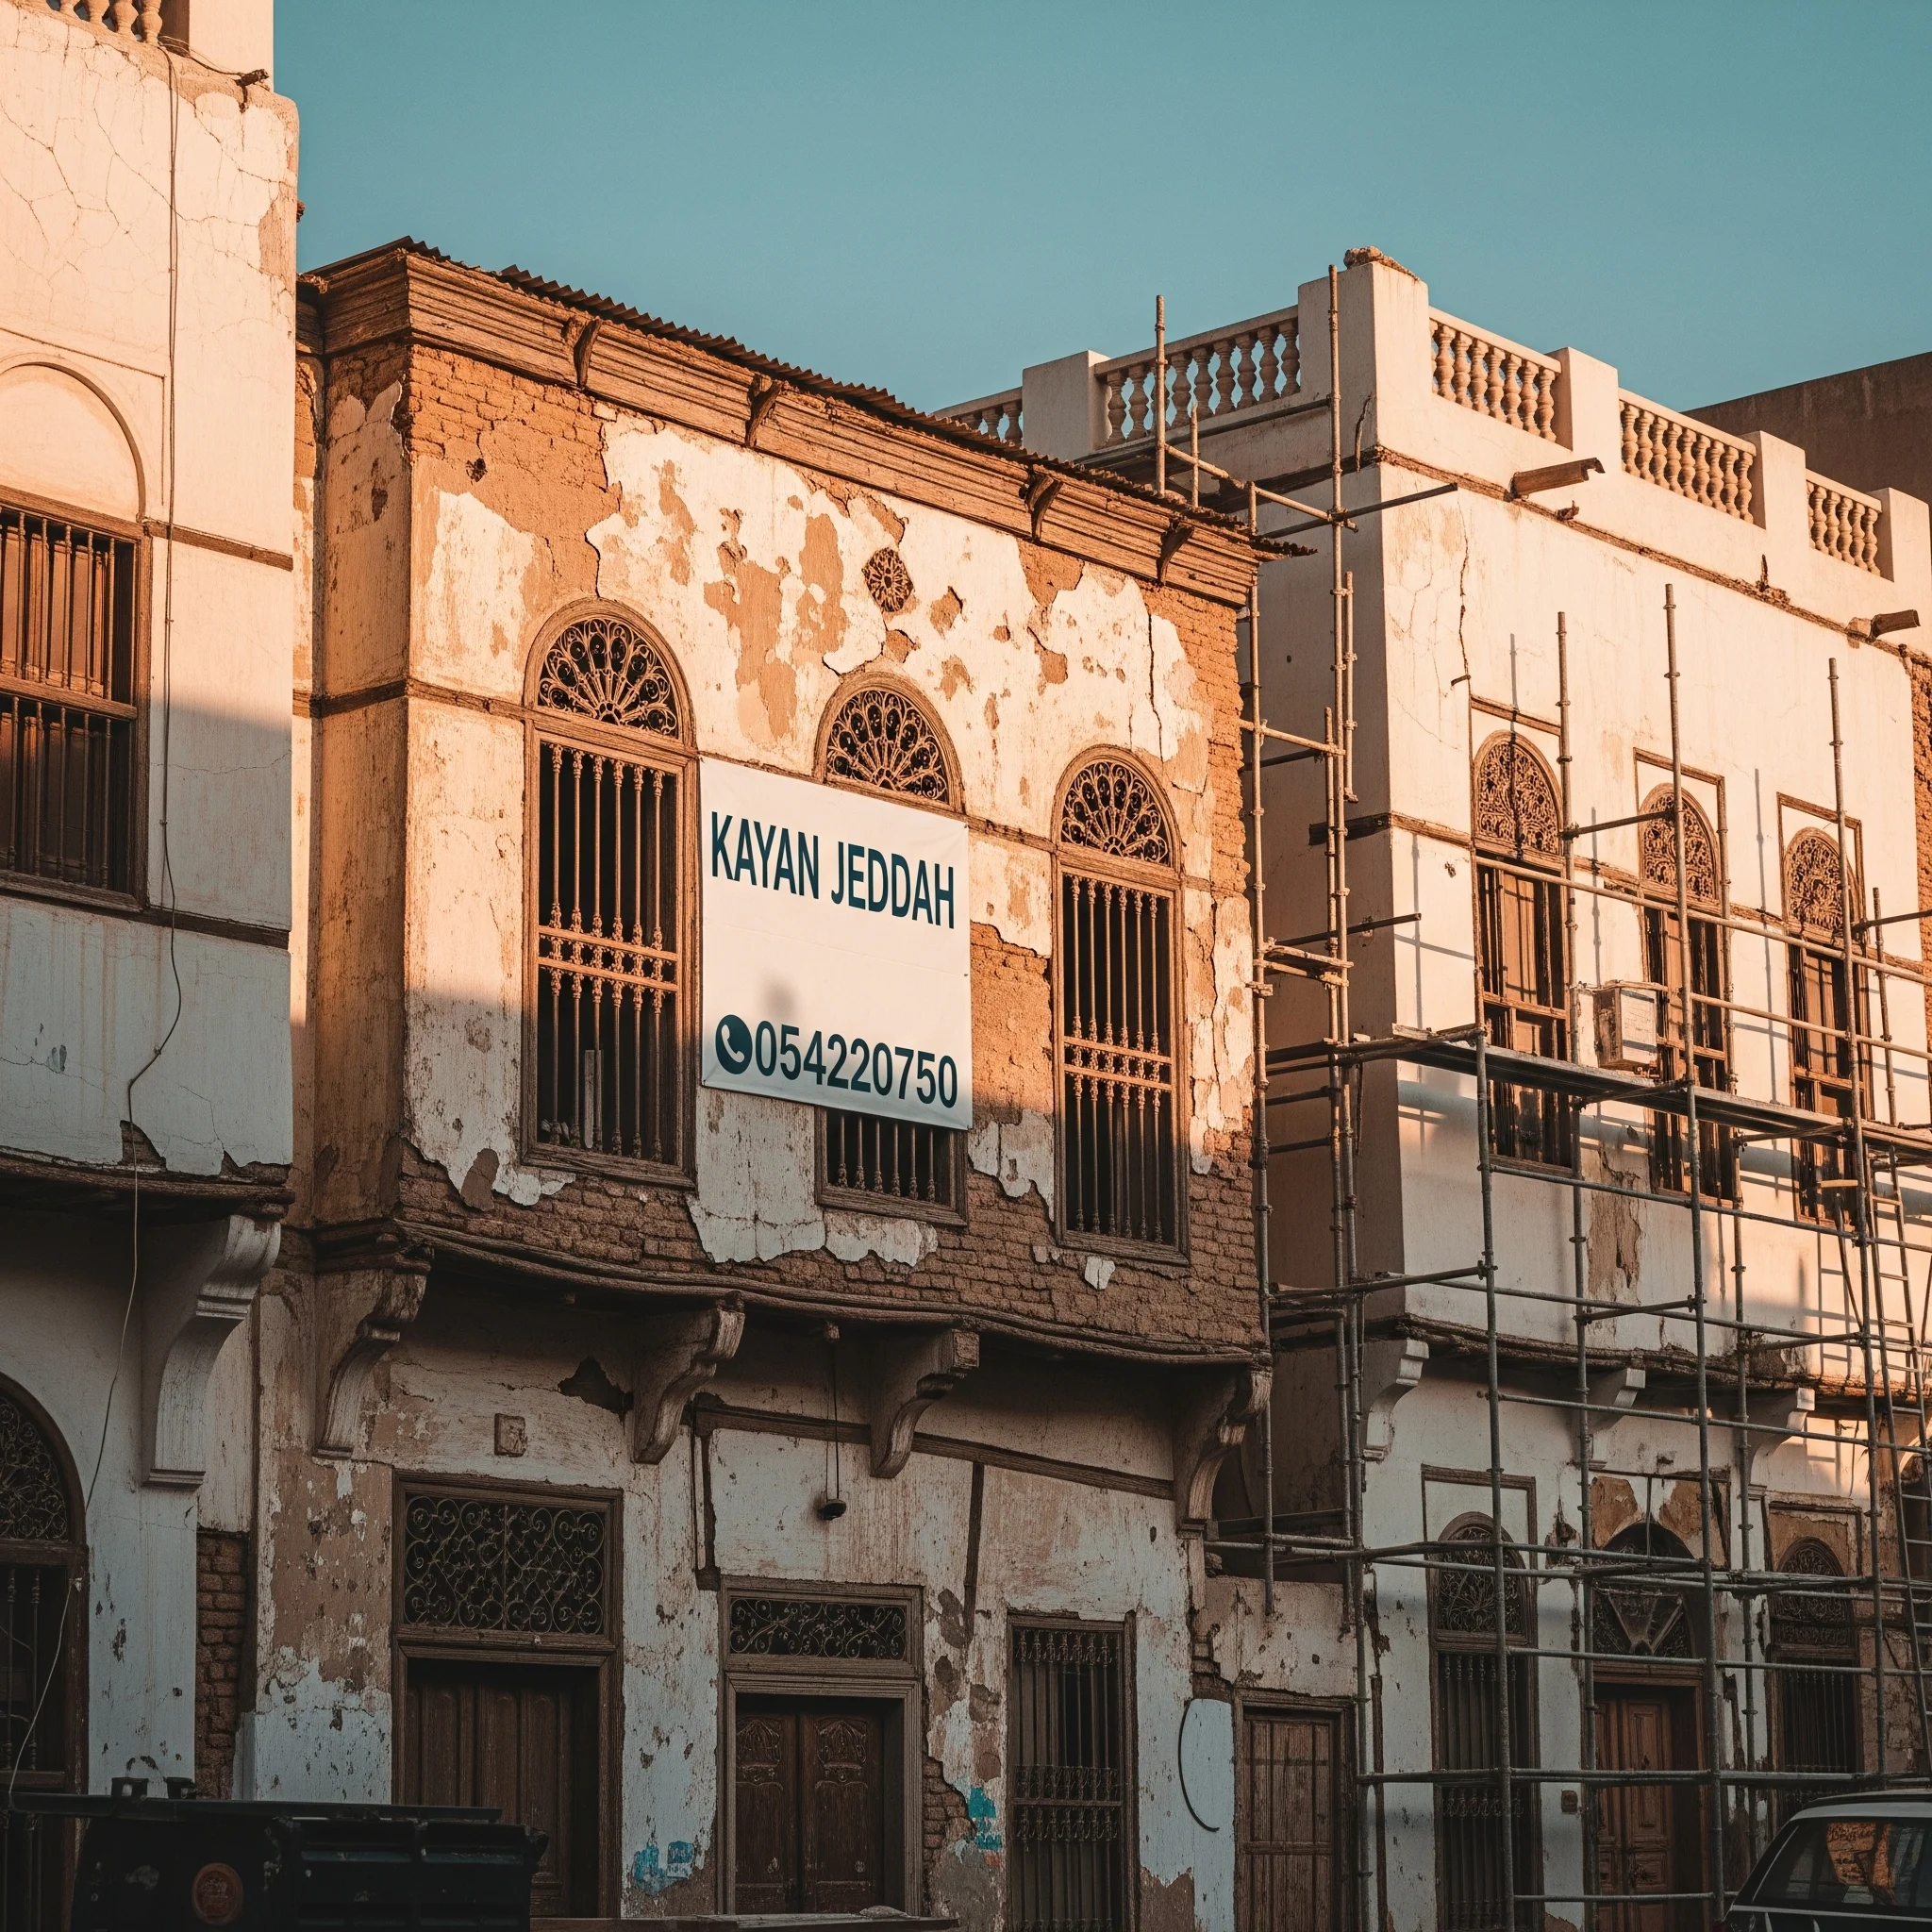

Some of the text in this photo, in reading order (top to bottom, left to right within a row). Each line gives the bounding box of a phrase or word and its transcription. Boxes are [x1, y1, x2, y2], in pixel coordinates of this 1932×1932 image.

[711, 811, 955, 929] KAYAN JEDDAH
[755, 1020, 958, 1108] 054220750
